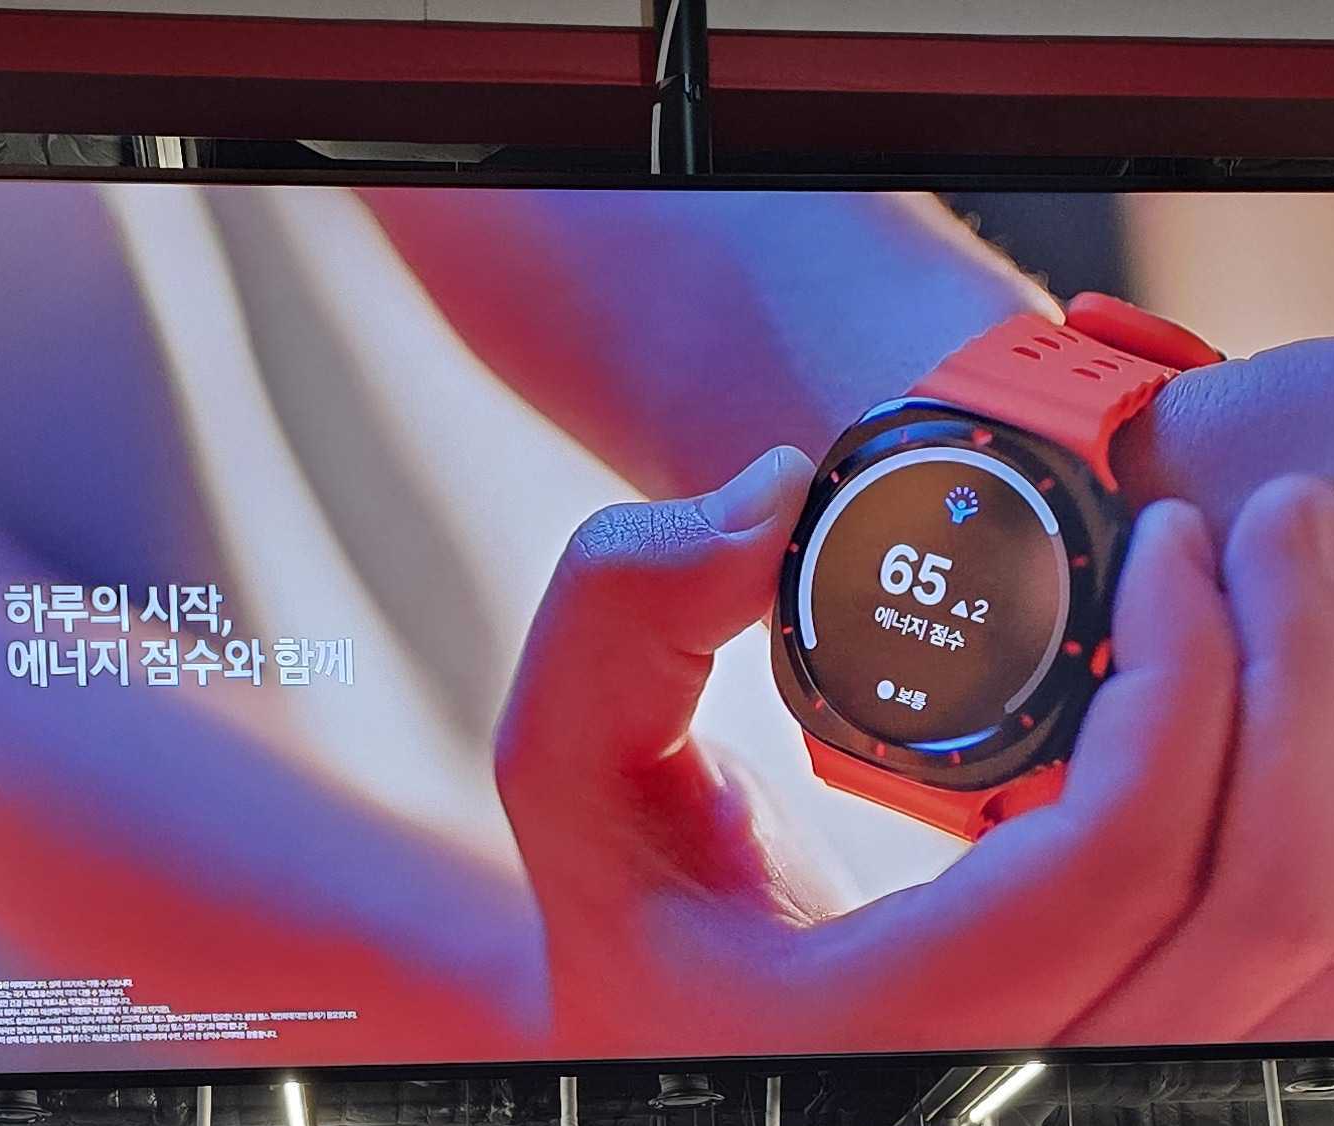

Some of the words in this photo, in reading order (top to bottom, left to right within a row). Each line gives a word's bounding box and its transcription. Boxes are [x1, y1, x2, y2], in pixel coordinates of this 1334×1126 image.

[880, 544, 953, 605] 65
[4, 584, 130, 633] 하루의
[140, 584, 233, 636] 시작,
[874, 605, 929, 641] 에너지
[929, 624, 966, 651] 점수
[7, 638, 130, 688] 에너지
[140, 638, 266, 687] 점수와
[273, 637, 355, 687] 함께
[895, 686, 929, 711] 보통
